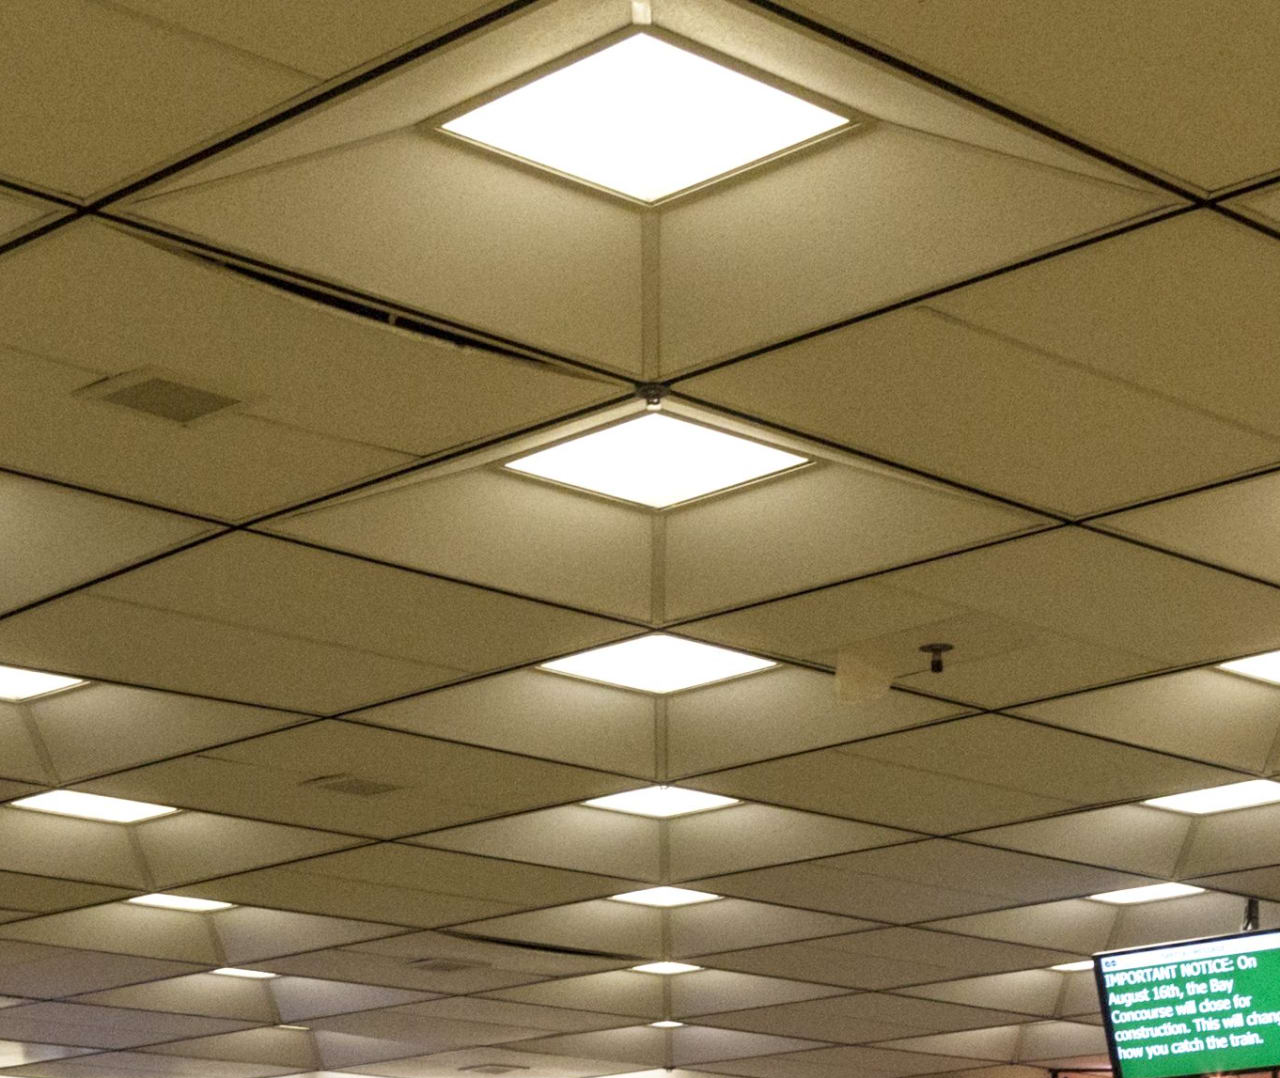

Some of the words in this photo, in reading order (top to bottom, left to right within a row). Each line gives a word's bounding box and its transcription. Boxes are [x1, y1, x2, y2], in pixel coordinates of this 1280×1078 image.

[1105, 964, 1178, 988] IMPORTANT
[1181, 957, 1235, 978] NOTICE:
[1237, 955, 1258, 969] On
[1108, 987, 1150, 1007] August
[1152, 985, 1184, 1001] 16th,
[1186, 980, 1208, 995] the
[1210, 978, 1234, 995] Bay
[1111, 1004, 1174, 1024] Concourse
[1176, 1000, 1196, 1015] will
[1199, 997, 1231, 1014] close
[1233, 994, 1252, 1010] for
[1114, 1022, 1191, 1042] construction.
[1192, 1016, 1221, 1033] This
[1223, 1013, 1244, 1028] will
[1118, 1044, 1143, 1060] how
[1146, 1042, 1168, 1060] you
[1171, 1036, 1204, 1053] catch
[1207, 1033, 1229, 1049] the
[1231, 1030, 1264, 1047] train.
